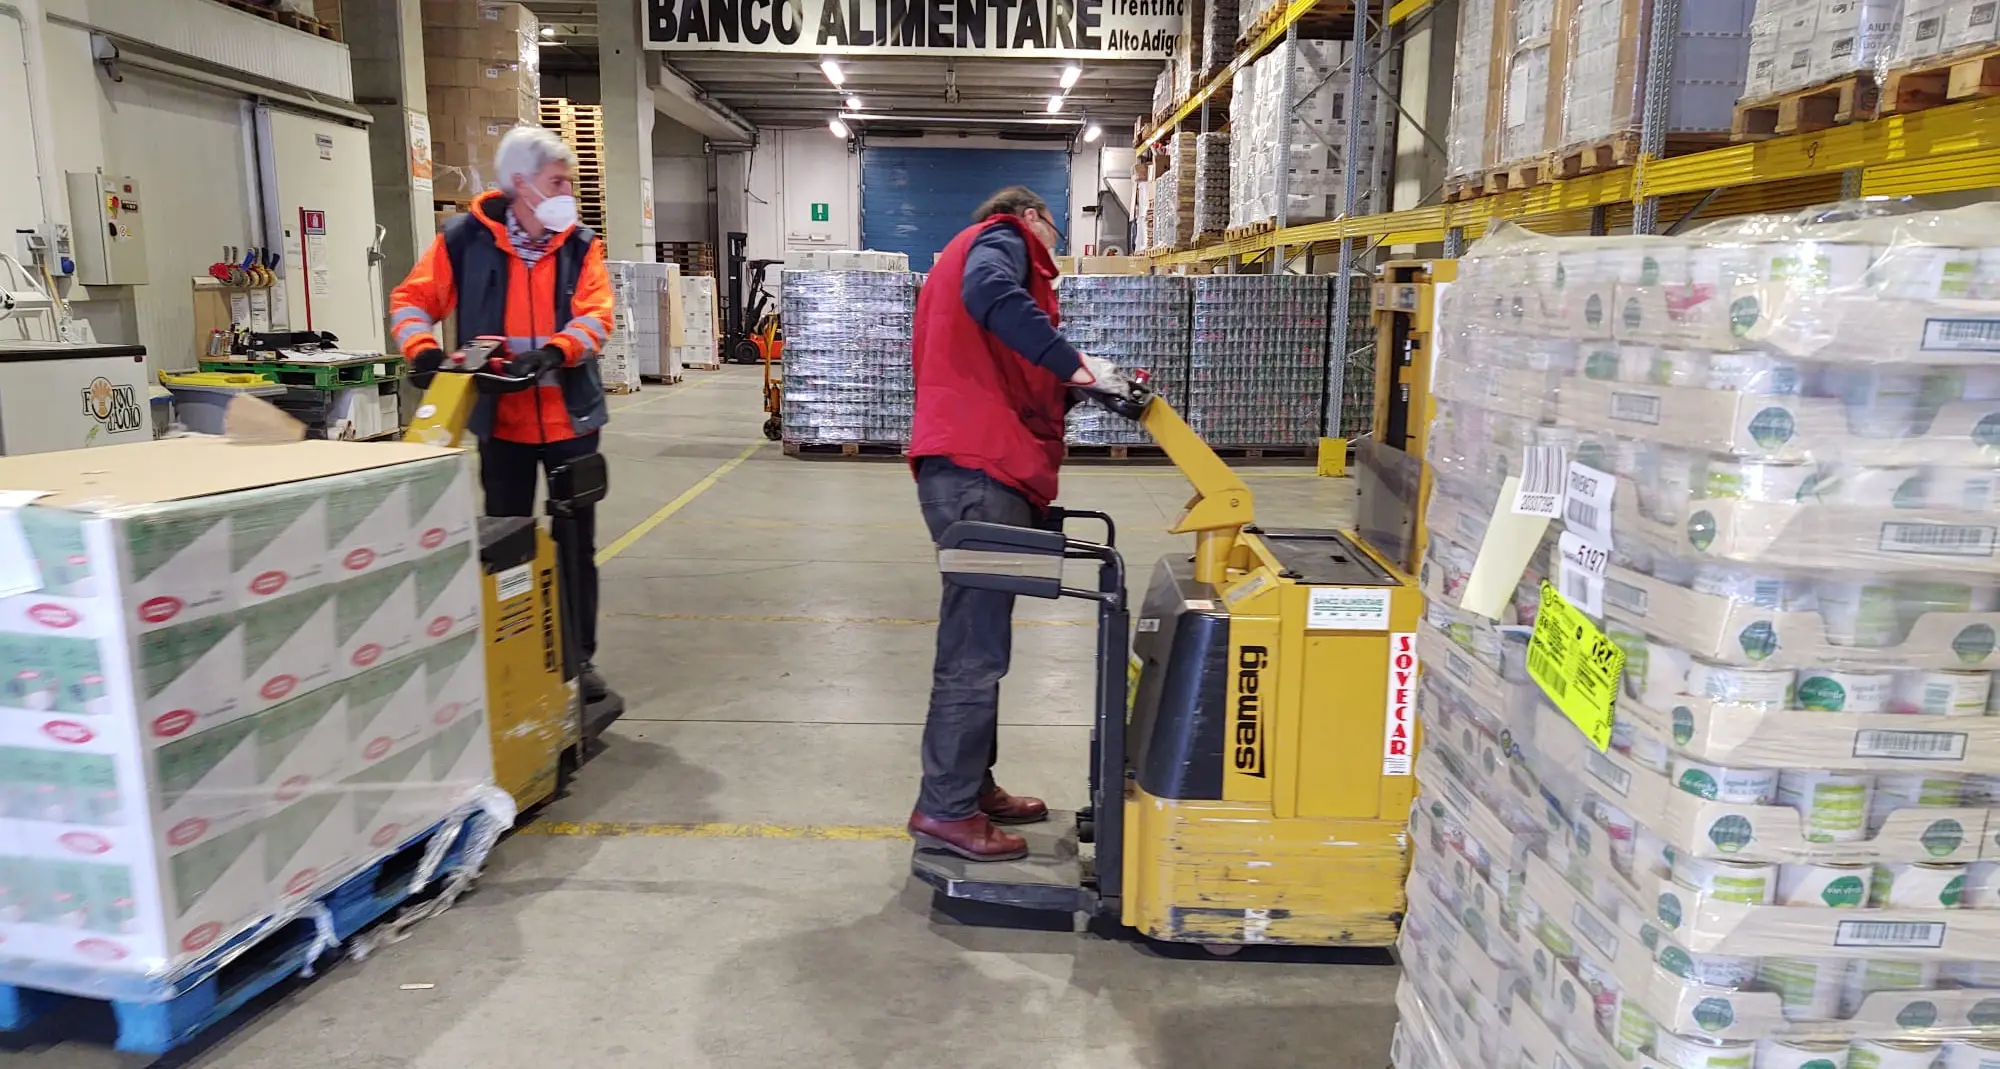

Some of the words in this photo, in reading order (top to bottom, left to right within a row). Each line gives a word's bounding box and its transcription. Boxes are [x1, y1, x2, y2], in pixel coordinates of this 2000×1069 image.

[650, 0, 804, 46] BANCO
[815, 0, 1102, 50] ALIMENTARE
[1107, 29, 1139, 51] Alto
[1578, 544, 1605, 574] 5197
[1235, 645, 1269, 771] samag
[1389, 636, 1413, 755] SOVECAR
